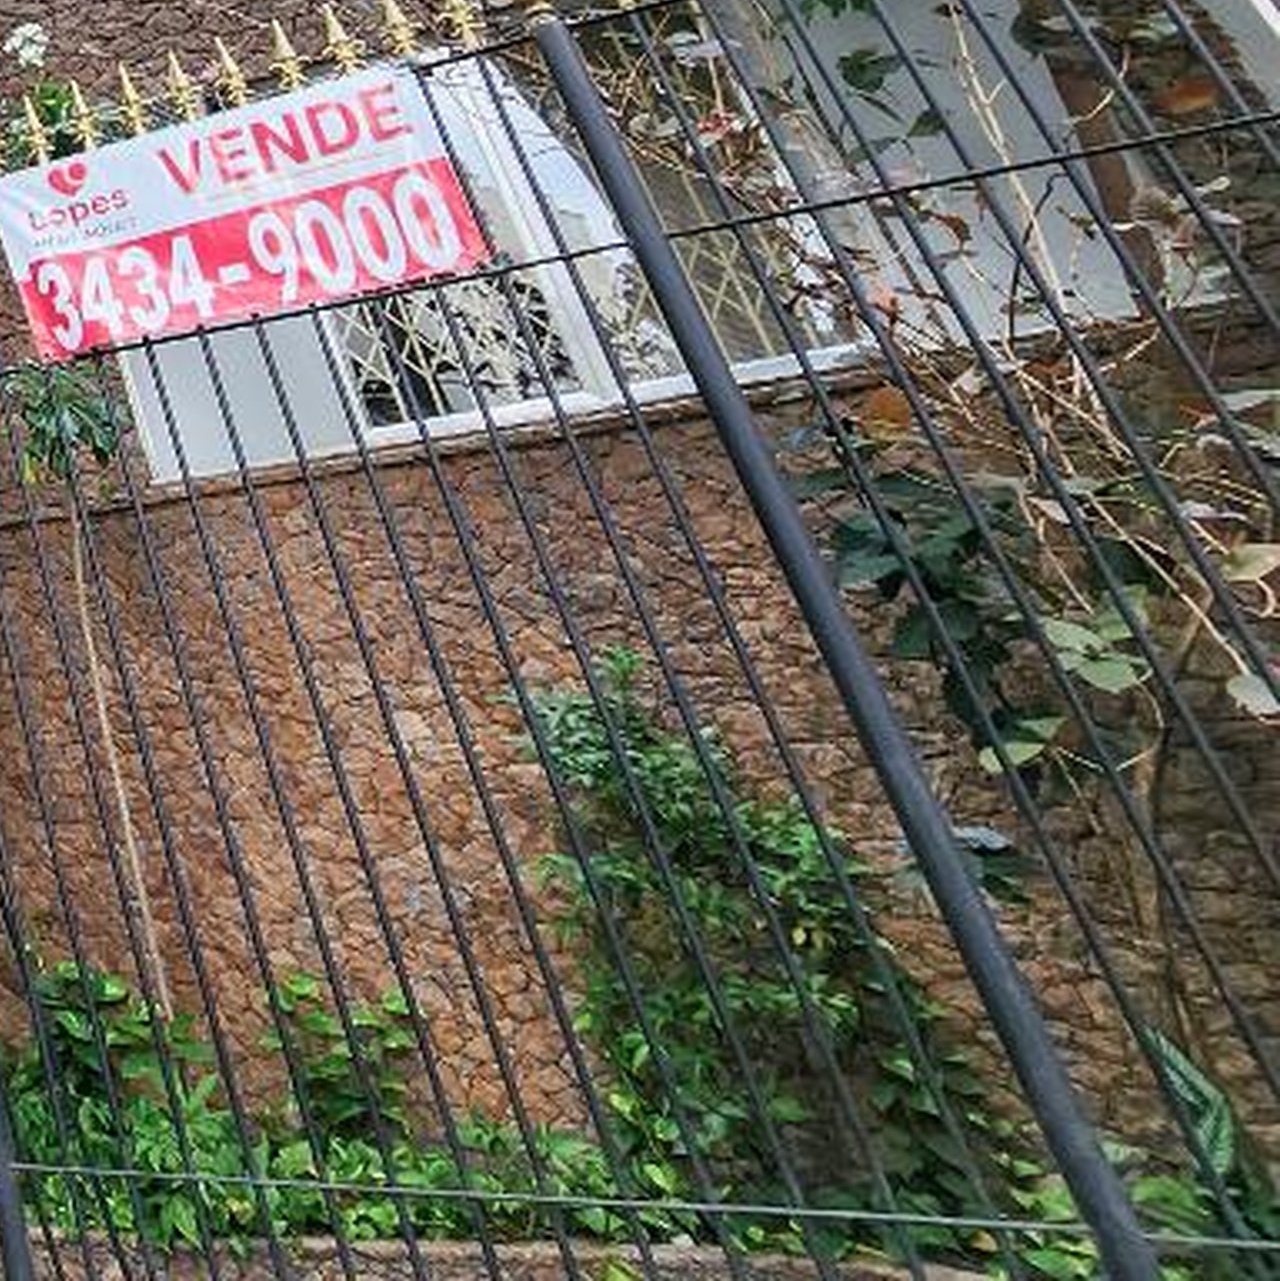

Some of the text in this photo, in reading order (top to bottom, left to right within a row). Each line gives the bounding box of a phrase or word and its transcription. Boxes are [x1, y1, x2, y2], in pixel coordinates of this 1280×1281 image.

[157, 82, 413, 195] VENDE
[28, 189, 129, 230] Lopes
[38, 174, 462, 352] 3434-9000
